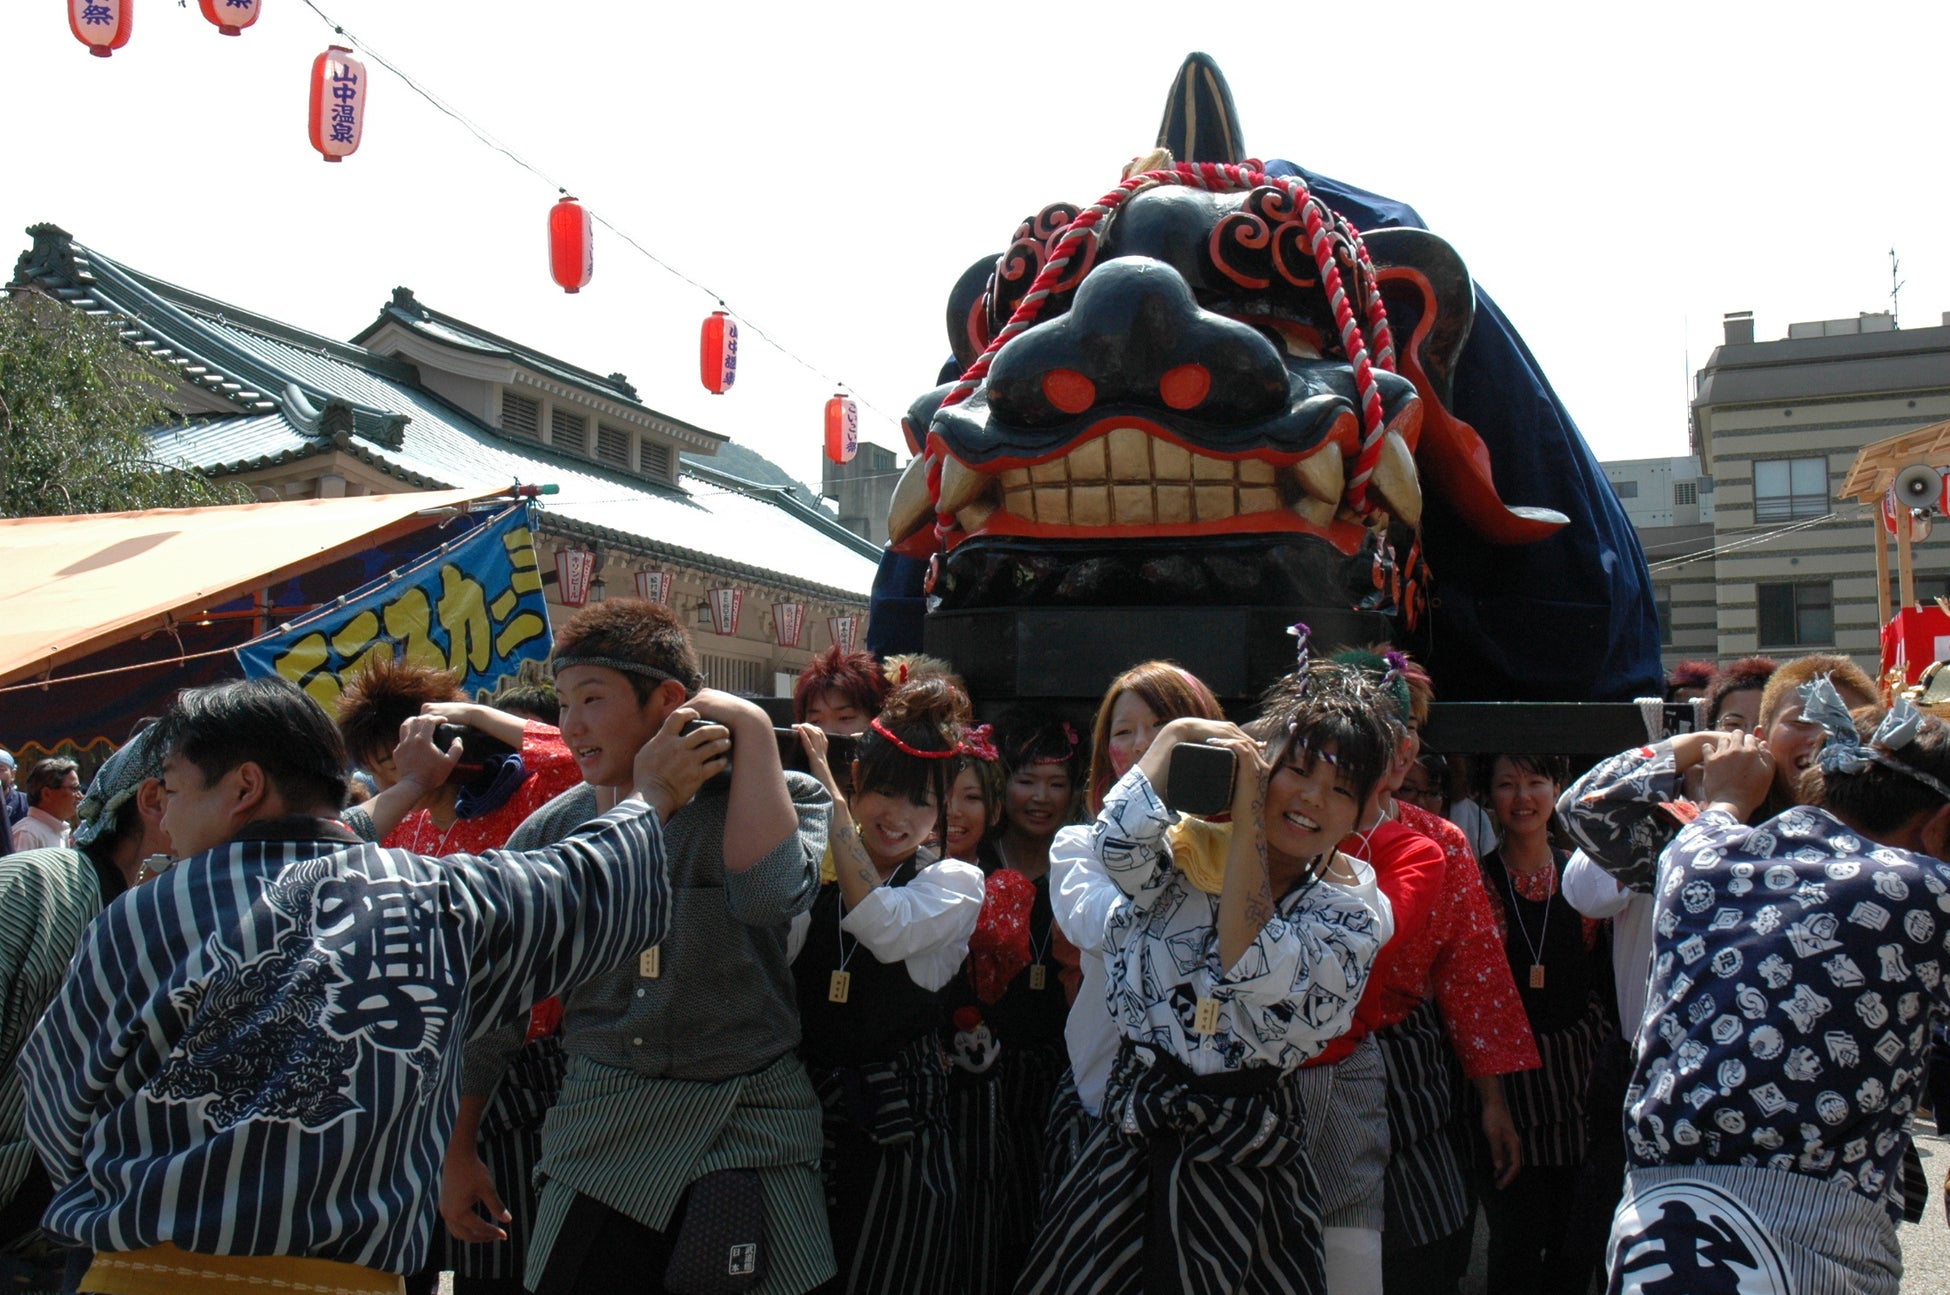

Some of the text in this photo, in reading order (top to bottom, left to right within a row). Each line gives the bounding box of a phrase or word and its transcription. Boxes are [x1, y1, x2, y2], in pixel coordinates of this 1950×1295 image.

[329, 64, 357, 144] 山中温泉
[570, 556, 581, 599] キリンビール
